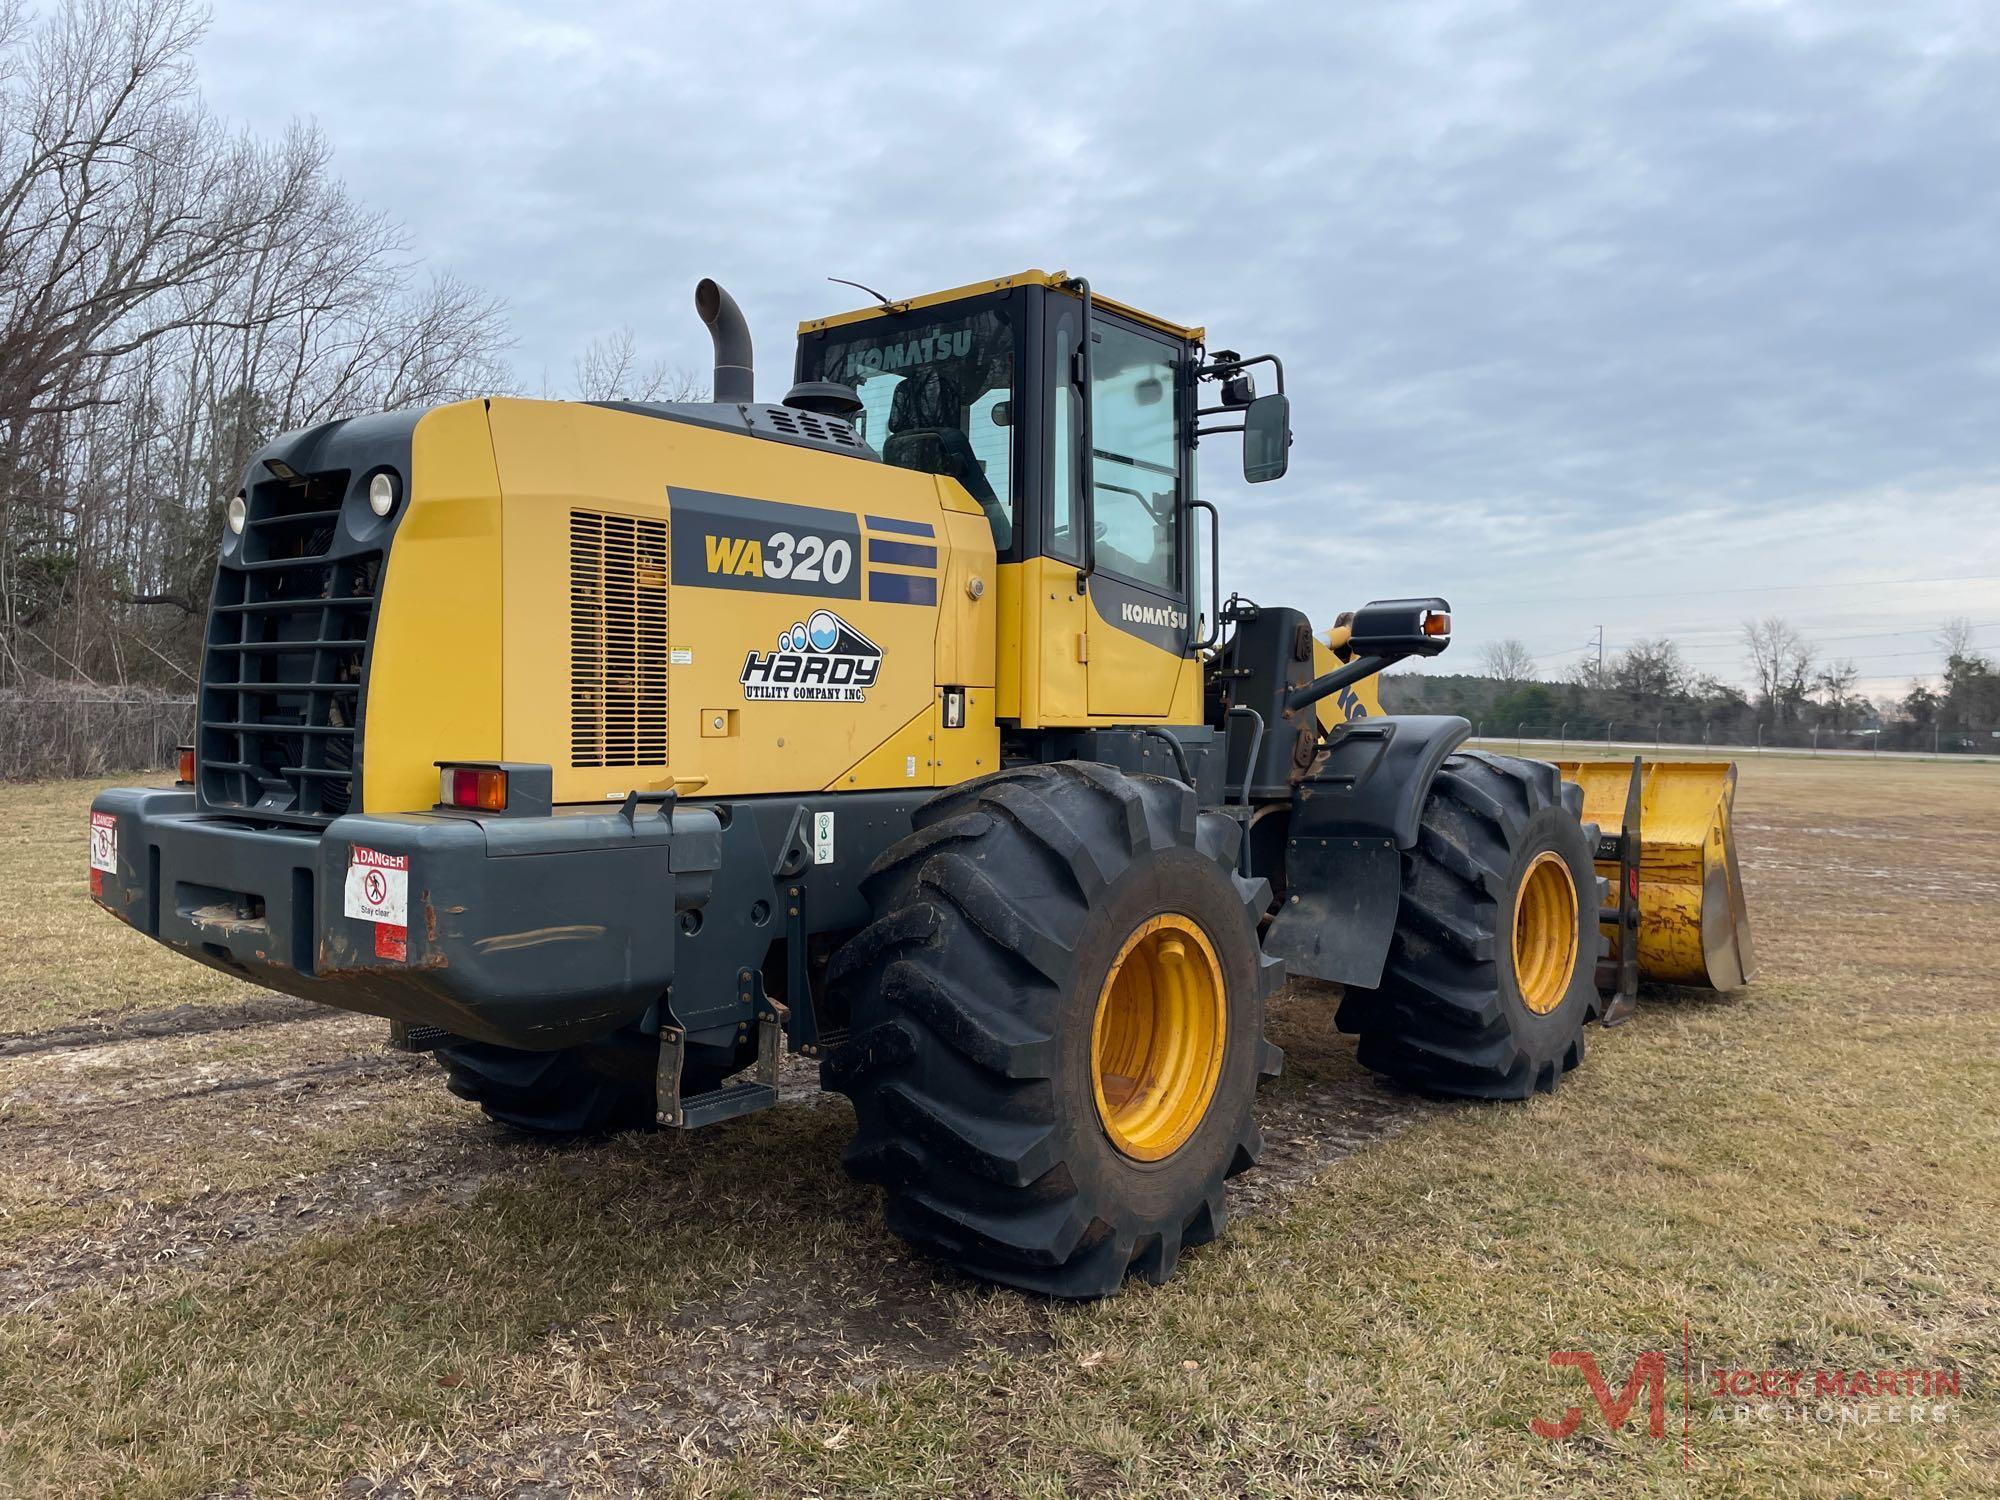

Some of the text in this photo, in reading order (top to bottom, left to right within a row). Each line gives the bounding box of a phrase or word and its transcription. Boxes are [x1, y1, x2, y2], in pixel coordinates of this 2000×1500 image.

[847, 328, 972, 378] KOMATSU
[705, 532, 852, 584] WA320
[1122, 603, 1187, 630] KOMATSU
[746, 685, 864, 700] UTILITY COMPANY INC.
[360, 851, 404, 868] DANGER
[360, 905, 390, 918] Stay clear
